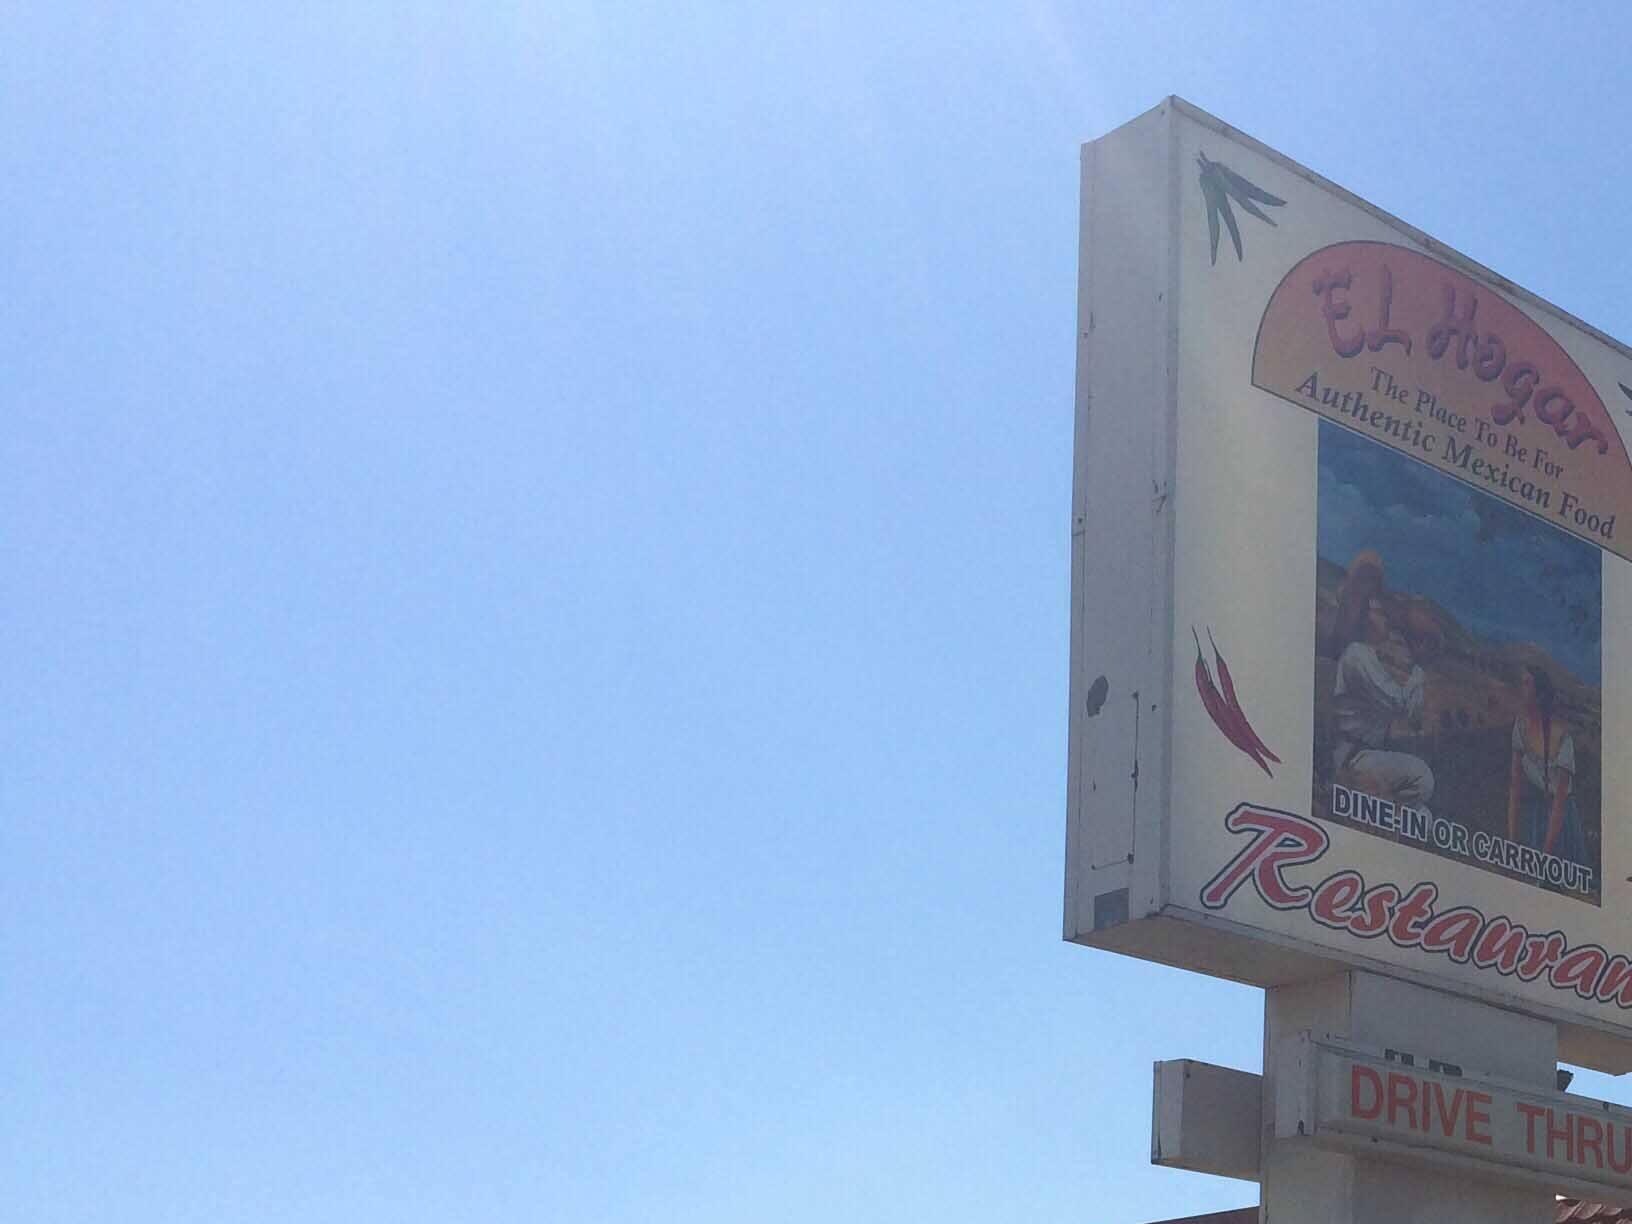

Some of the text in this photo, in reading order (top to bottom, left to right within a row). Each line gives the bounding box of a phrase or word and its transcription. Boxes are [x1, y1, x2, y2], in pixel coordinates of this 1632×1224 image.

[1370, 366, 1565, 480] The Place To Be For
[1426, 282, 1608, 456] Hogar
[1295, 371, 1617, 540] Authentic Mexican Food
[1332, 784, 1593, 893] DINE-IN OR CARRYOUT
[1351, 1065, 1632, 1175] DRIVE THRU
